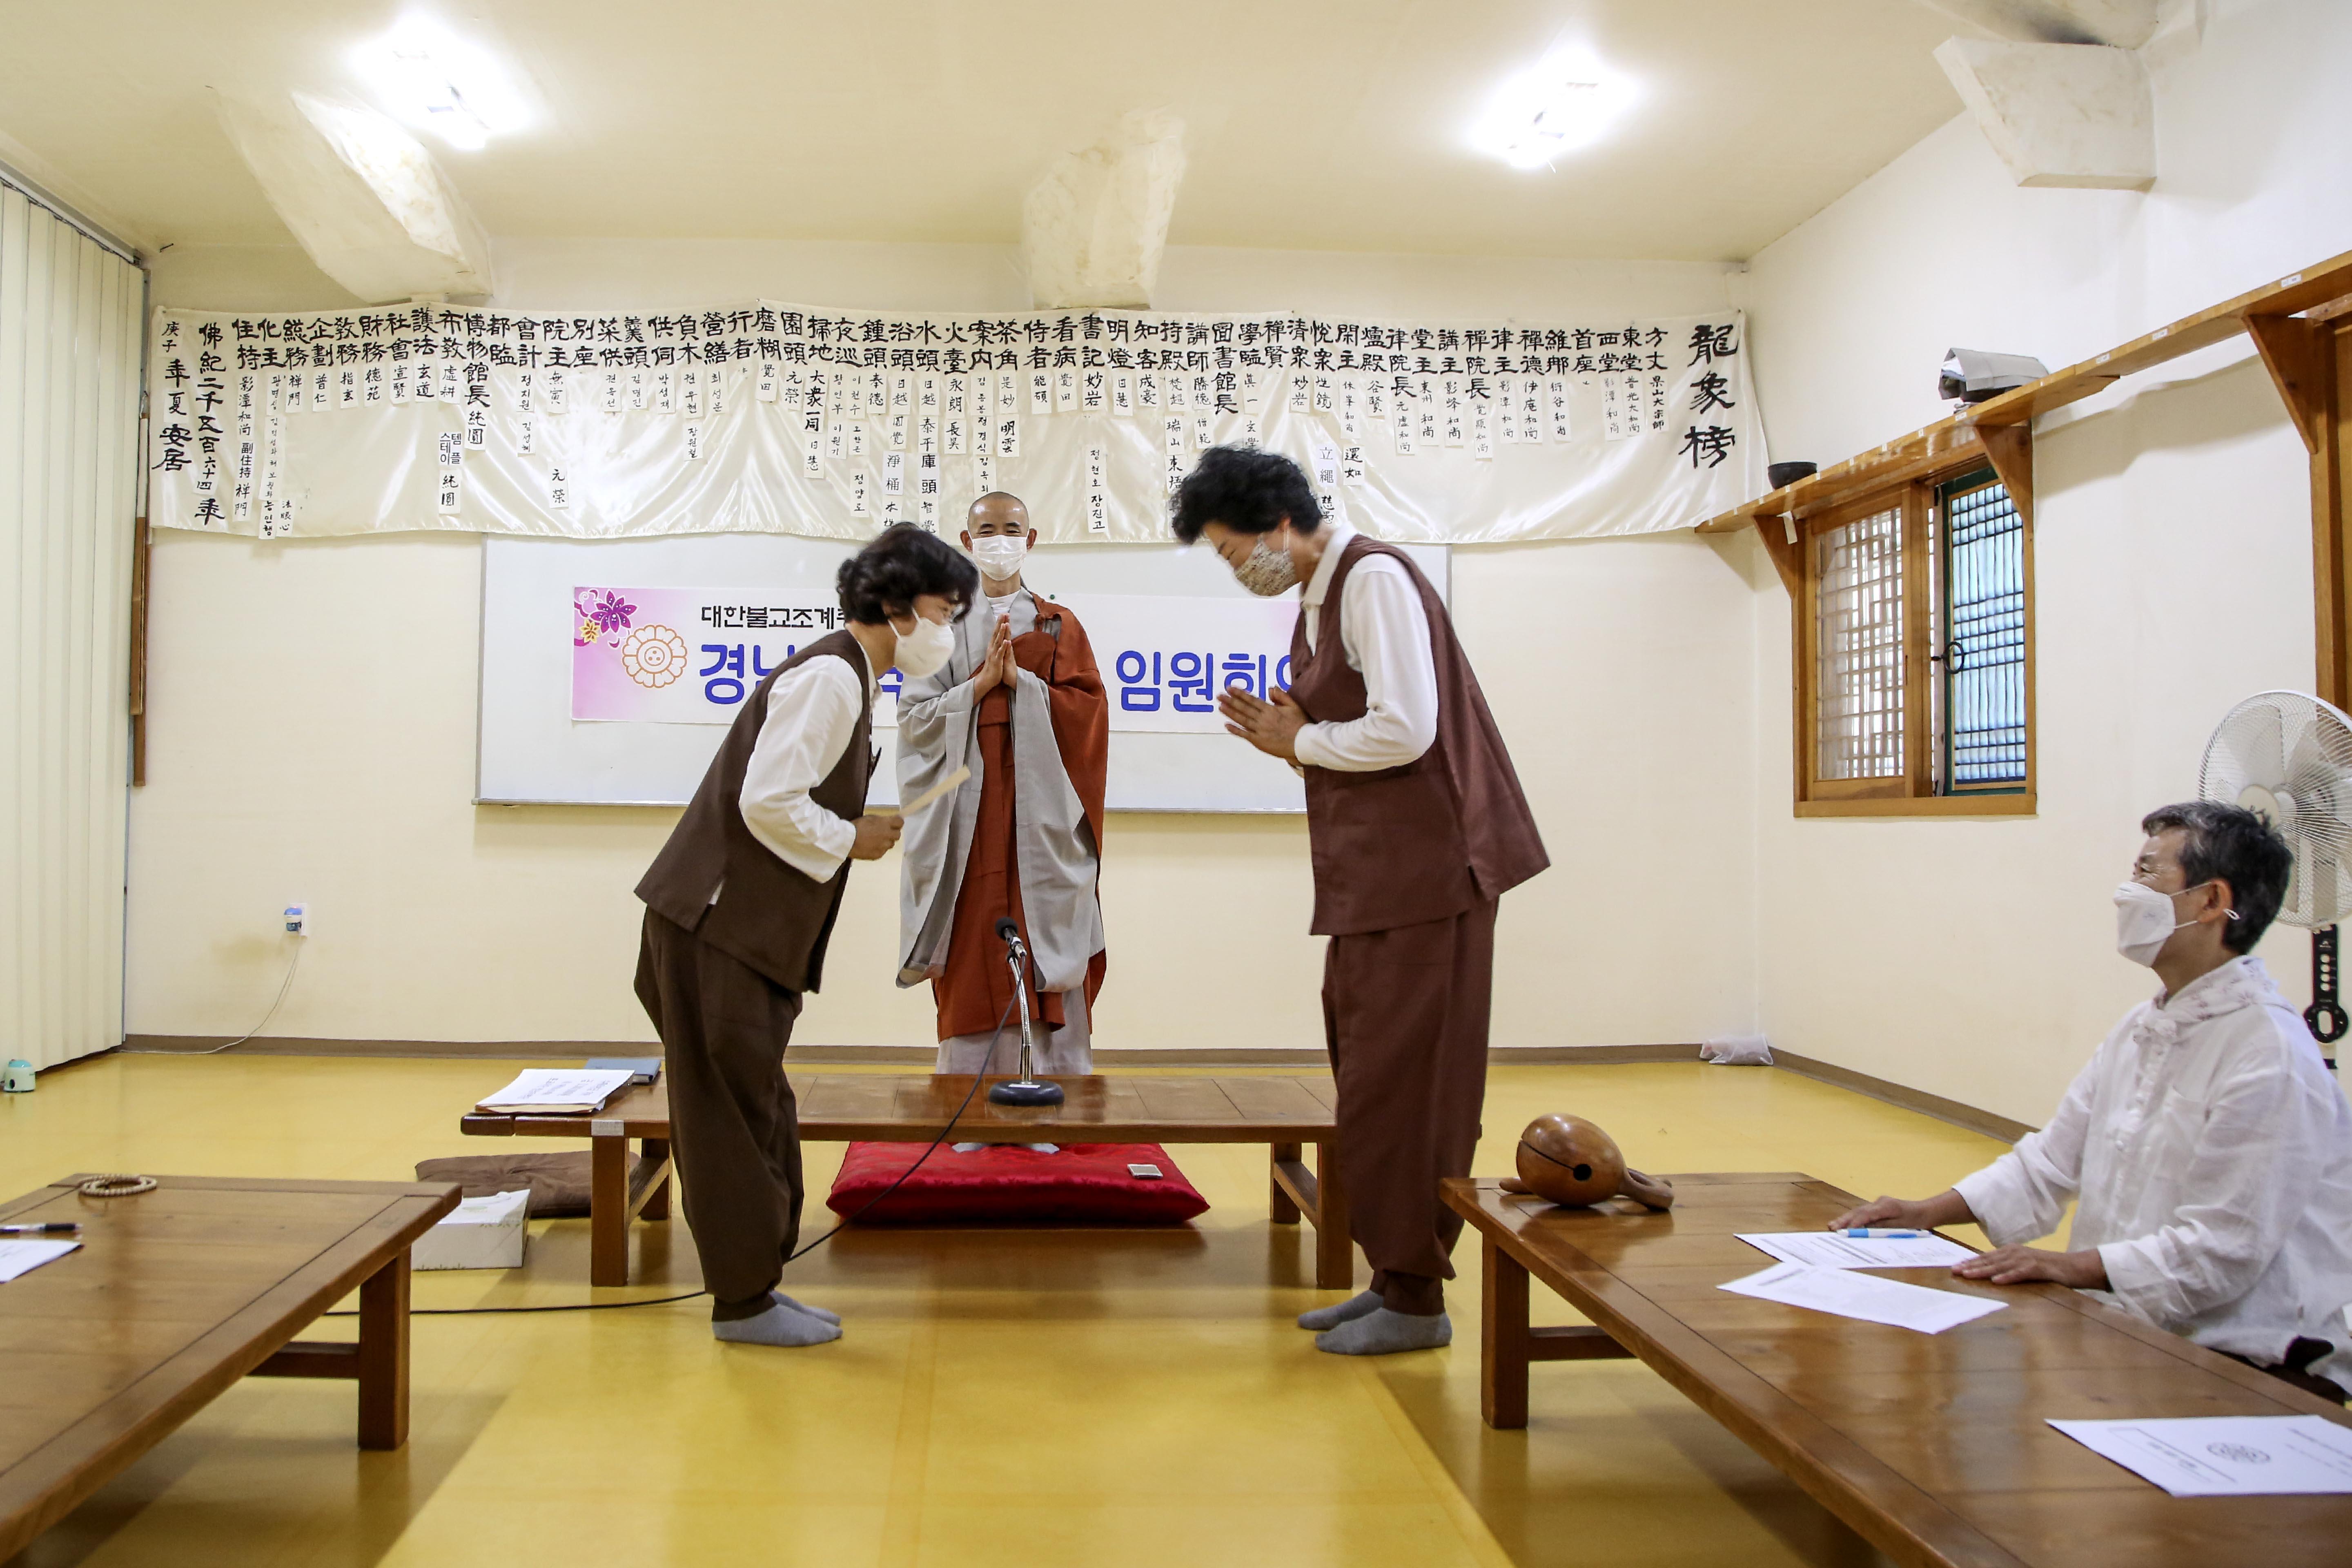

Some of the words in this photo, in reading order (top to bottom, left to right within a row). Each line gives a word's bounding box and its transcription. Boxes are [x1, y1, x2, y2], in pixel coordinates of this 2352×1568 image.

[258, 318, 286, 368] 化主
[307, 318, 334, 367] 企劃
[359, 314, 388, 363] 財務
[383, 313, 413, 361] 社會
[411, 307, 438, 354] 護法
[511, 317, 542, 368] 會計
[543, 318, 572, 368] 院主
[728, 310, 753, 360] 行者
[807, 314, 834, 361] 掃地
[888, 322, 915, 371] 浴頭
[913, 320, 942, 372] 水頭
[993, 318, 1022, 371] 茶角
[1023, 319, 1052, 370] 侍者
[1051, 316, 1078, 368] 看病
[1078, 313, 1105, 368] 書記
[1107, 319, 1136, 369] 明燈
[1134, 320, 1159, 370] 知客
[1158, 319, 1188, 371] 持殿
[1185, 322, 1209, 372] 講師
[1411, 329, 1438, 375] 堂主
[1437, 329, 1463, 375] 講主
[1571, 329, 1597, 374] 首座
[1597, 332, 1621, 373] 西堂
[1620, 326, 1643, 372] 東堂
[1645, 327, 1668, 370] 方丈
[416, 364, 434, 397] 玄道
[519, 374, 531, 410] 정지원
[1678, 324, 1739, 469] 龍象榜
[921, 454, 937, 494] 庫頭
